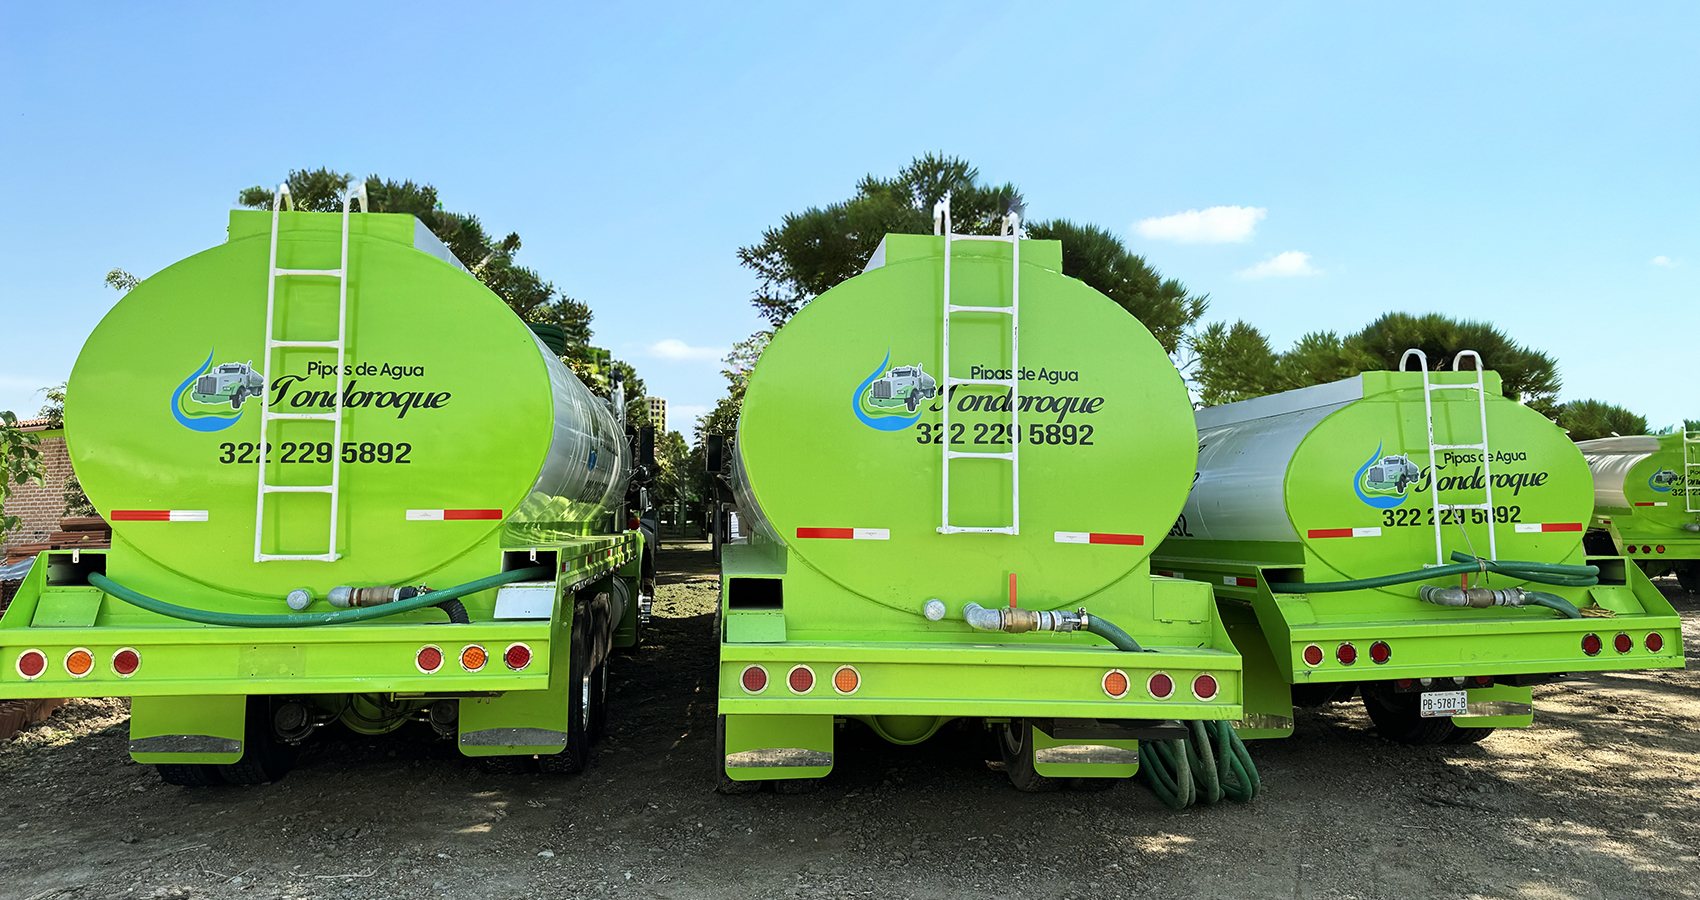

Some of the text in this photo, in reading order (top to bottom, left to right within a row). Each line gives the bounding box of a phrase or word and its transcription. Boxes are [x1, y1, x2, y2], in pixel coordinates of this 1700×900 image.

[355, 362, 378, 376] de
[380, 363, 424, 380] Agua
[971, 364, 1079, 385] Pipas de Agua
[260, 374, 452, 419] Tondoroque
[929, 384, 1105, 423] Tondoroque
[916, 423, 1094, 446] 322 229 5892
[219, 442, 411, 464] 322 229 5892
[1444, 451, 1477, 467] Pipas
[1495, 450, 1527, 465] Agua
[1415, 464, 1549, 495] Tondoroque
[1382, 508, 1421, 527] 322
[1471, 505, 1522, 525] 5892
[1423, 697, 1466, 709] PB-5787-B
